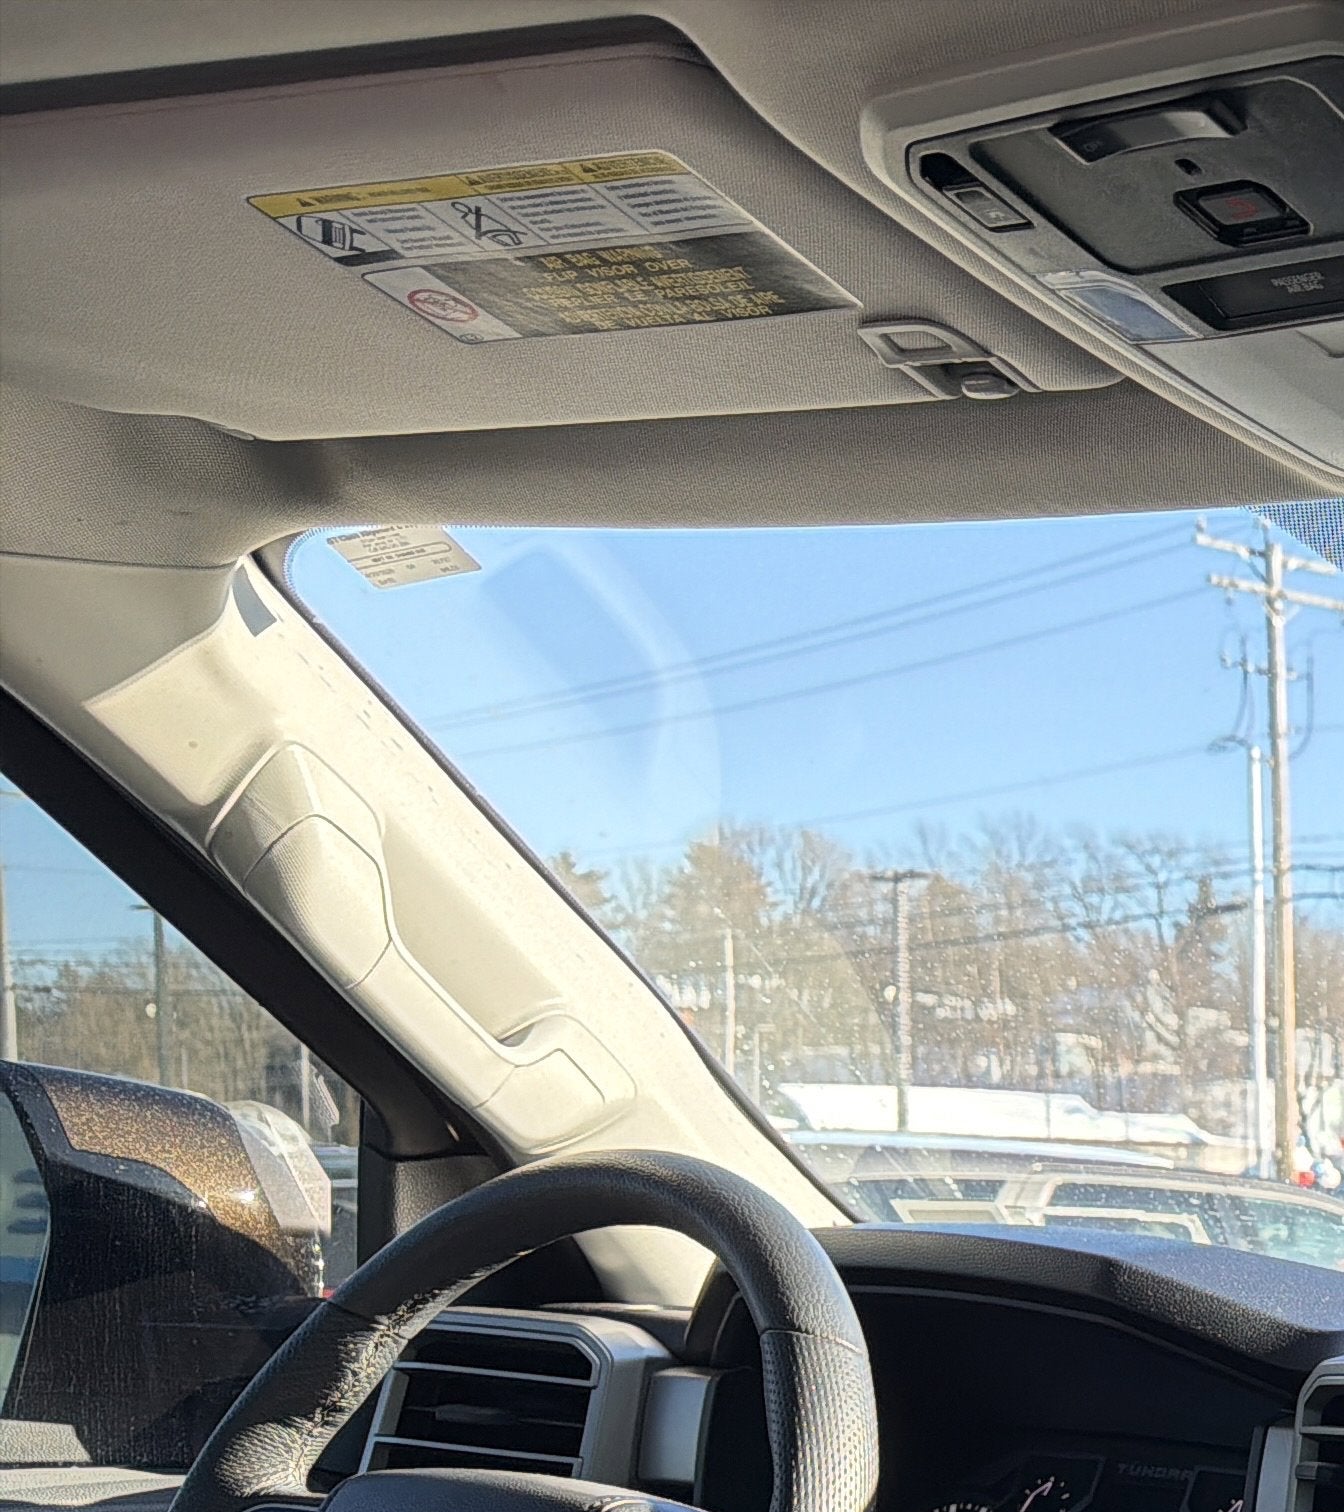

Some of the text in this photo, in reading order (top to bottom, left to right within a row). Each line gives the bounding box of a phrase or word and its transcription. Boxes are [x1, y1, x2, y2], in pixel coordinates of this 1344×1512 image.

[588, 263, 638, 278] VISOR
[644, 258, 692, 272] OVER
[655, 281, 755, 299] PARESOLEIL
[721, 304, 773, 319] VISOR
[1117, 1463, 1193, 1479] TUNDRA
